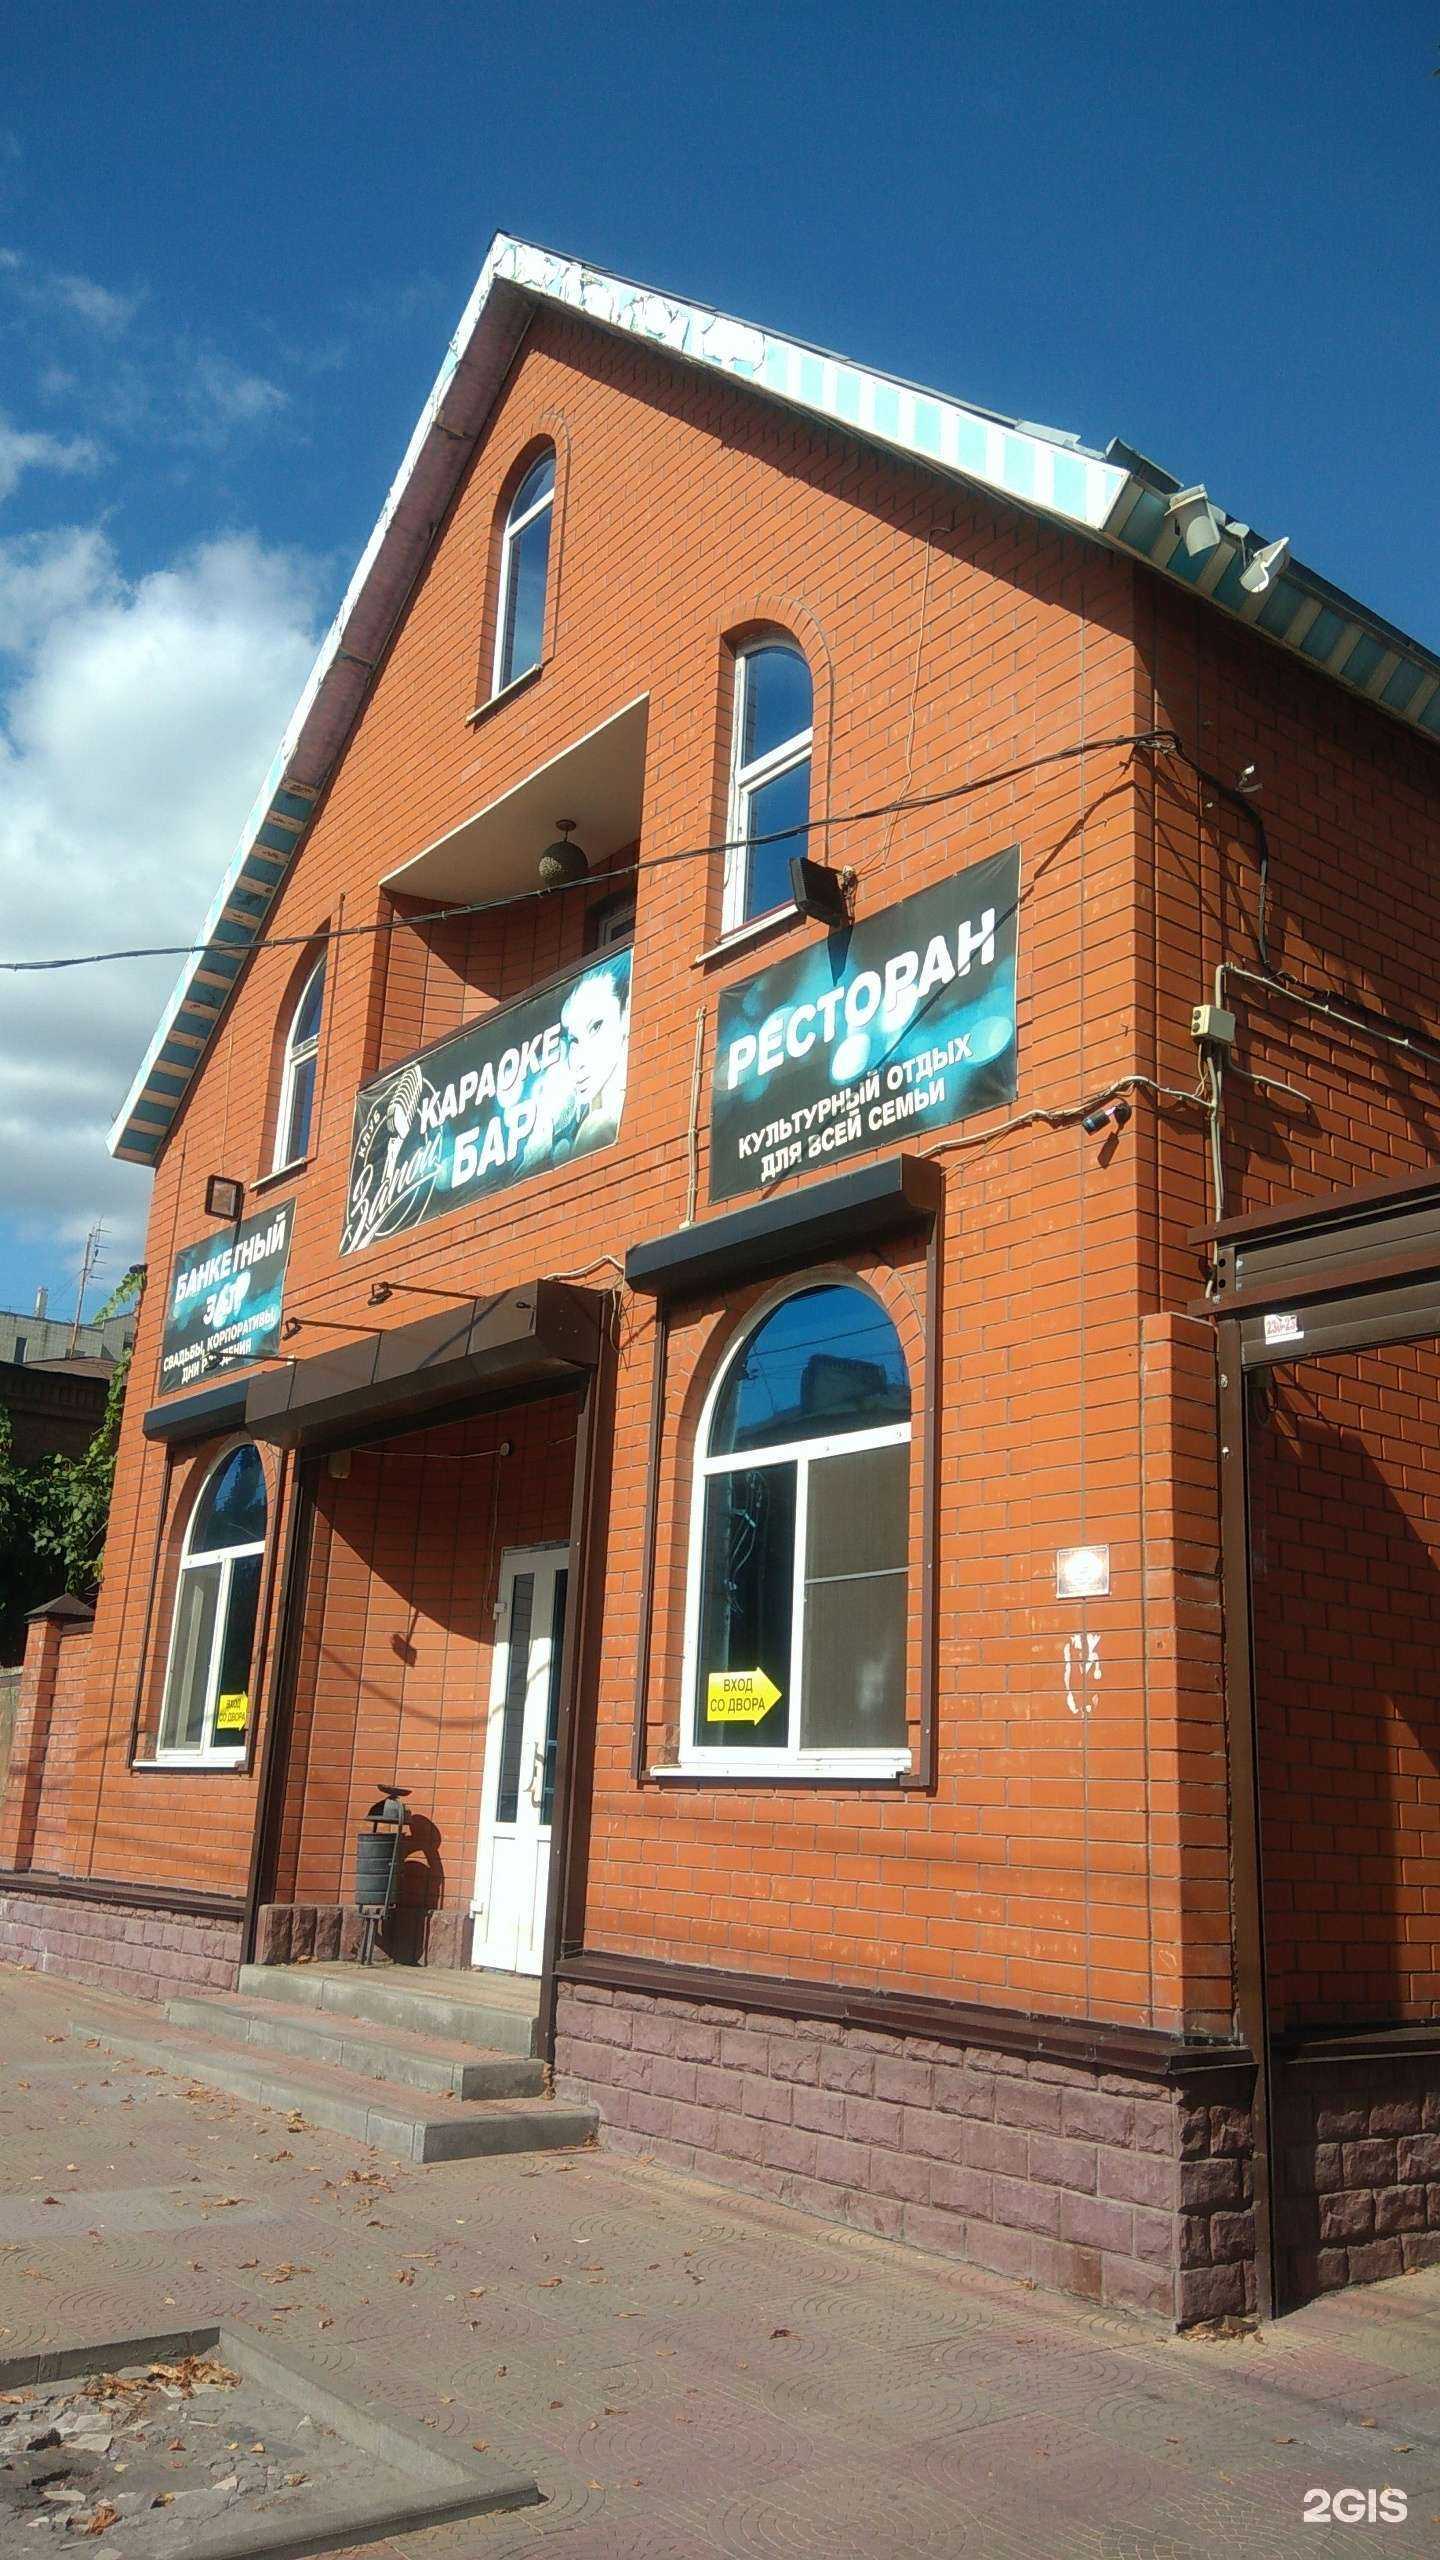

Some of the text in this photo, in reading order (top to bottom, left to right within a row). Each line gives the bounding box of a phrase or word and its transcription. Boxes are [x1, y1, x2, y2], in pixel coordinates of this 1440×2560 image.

[727, 907, 995, 1090] РЕСТОРАН
[418, 1022, 561, 1134] КАРАОКЕ
[738, 1032, 973, 1159] КУЛЬТУРНЫЙ ОТДЫХ
[451, 1103, 539, 1188] БАР
[761, 1080, 946, 1182] ДЛЯ ВСЕЙ СЕМЬИ
[175, 1211, 287, 1303] БАНКЕТНЫЙ
[203, 1273, 250, 1325] ЗАЛ
[181, 1361, 200, 1384] ДНИ
[207, 1309, 276, 1351] КОРПОРАТИВЫ
[710, 1697, 765, 1714] СО ДВОРА
[723, 1678, 753, 1694] ВХОД
